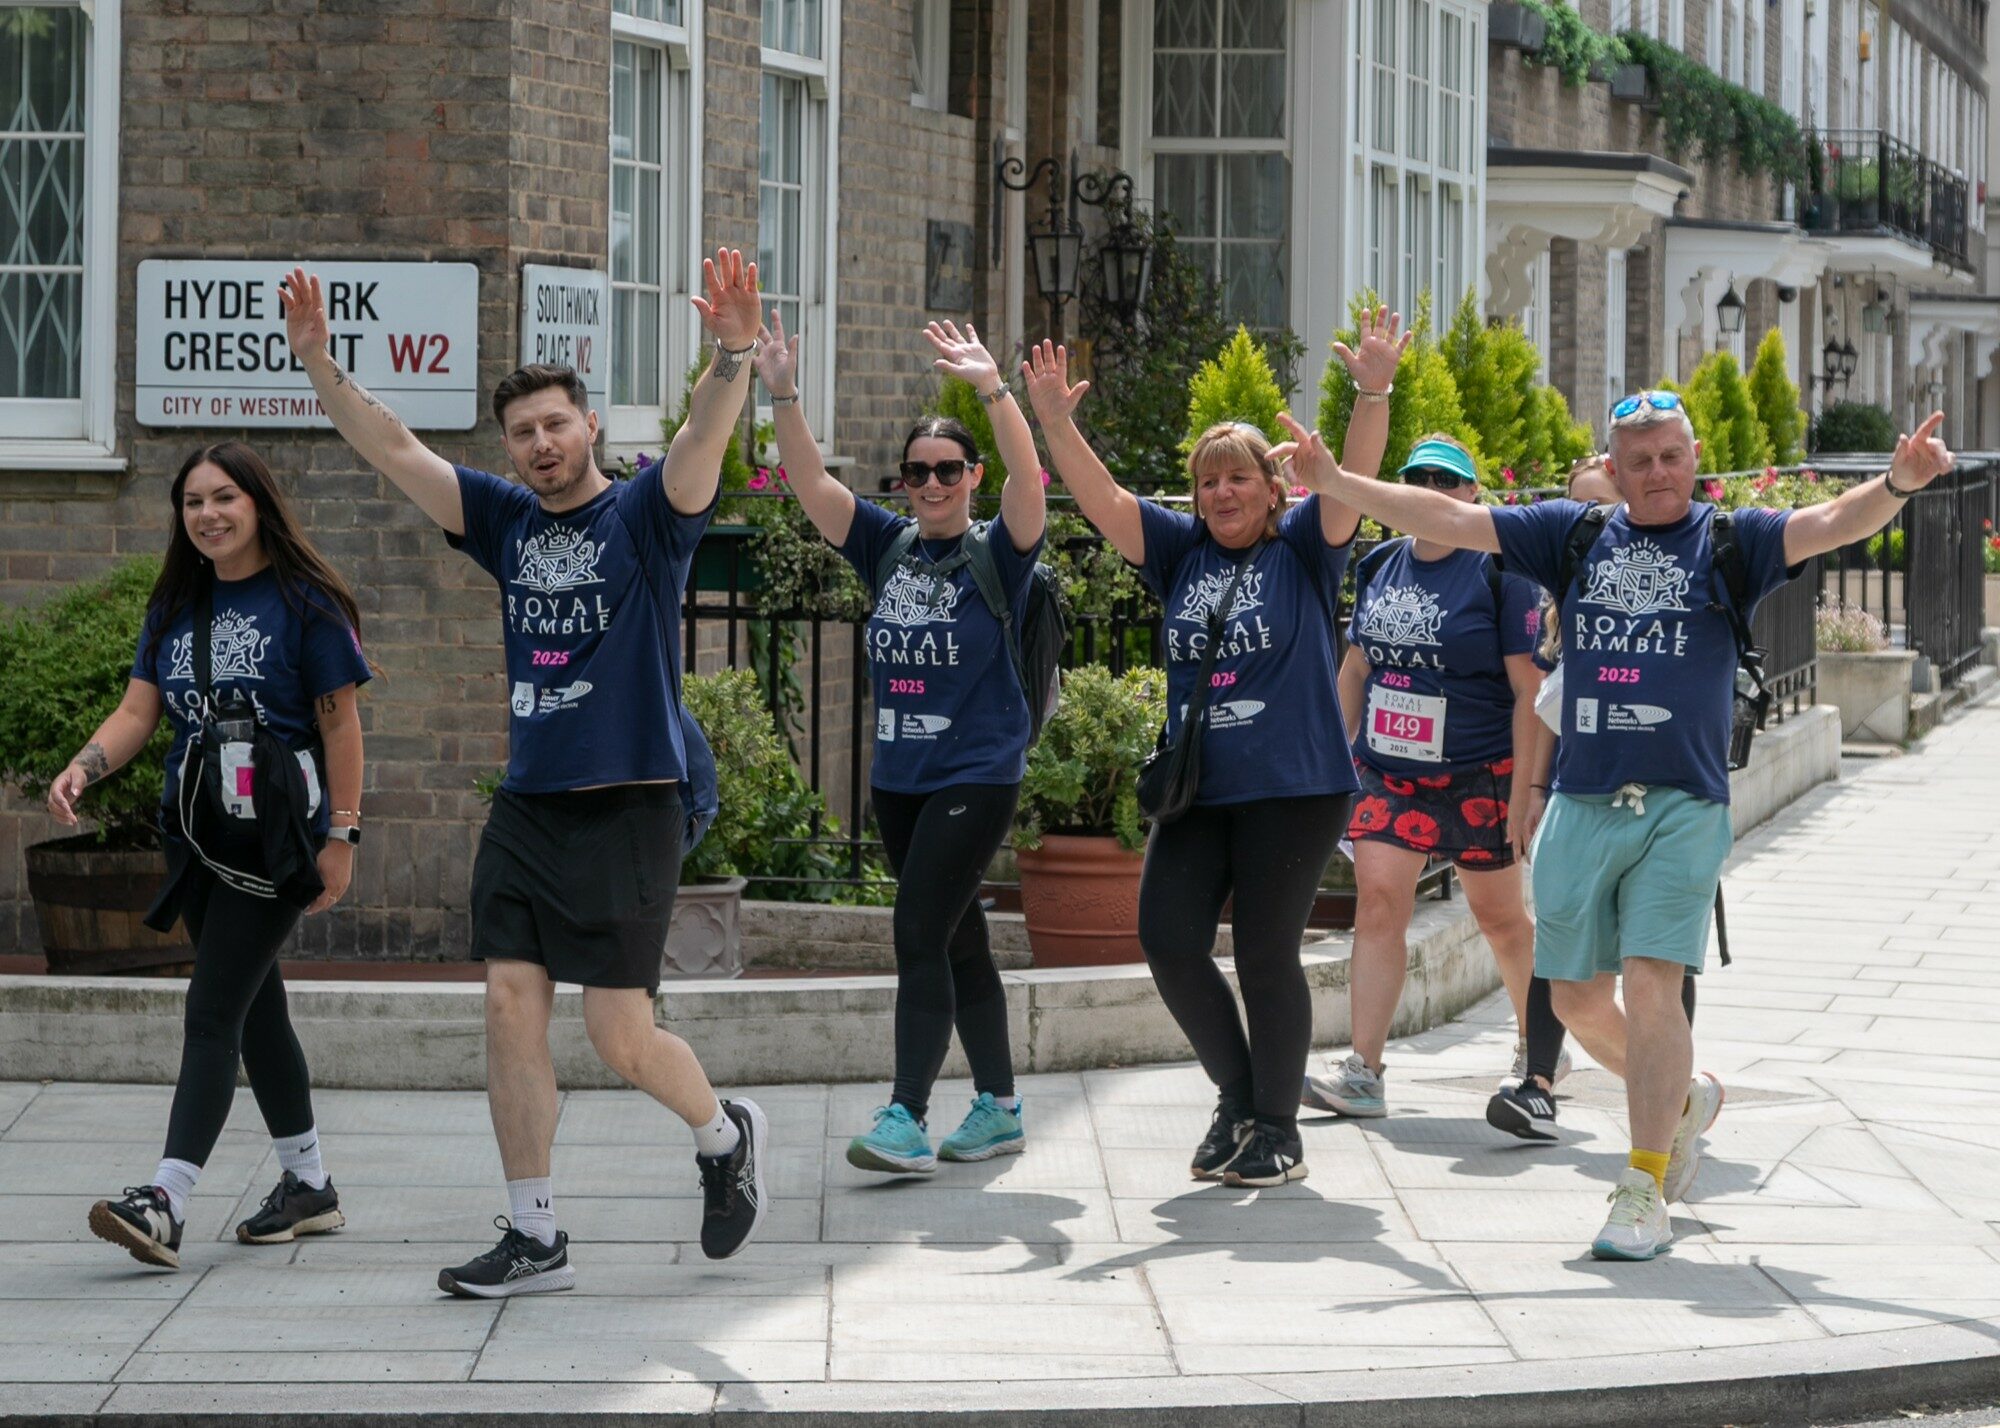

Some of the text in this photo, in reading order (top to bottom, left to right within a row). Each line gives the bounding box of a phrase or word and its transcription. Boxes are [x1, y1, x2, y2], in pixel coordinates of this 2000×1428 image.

[165, 280, 380, 321] HYDE RK
[537, 284, 599, 326] SOUTHWICK
[164, 331, 450, 374] CRESCT W2
[576, 335, 592, 374] W2
[163, 396, 327, 416] CITY OF WESTMIN
[508, 594, 610, 618] ROYAL
[1168, 614, 1270, 649] ROAL
[1576, 613, 1688, 640] ROYAL
[865, 628, 960, 650] ROYAL
[1576, 634, 1686, 656] RAMBLE
[532, 650, 570, 665] 2025
[1208, 671, 1237, 687] 025
[1381, 671, 1411, 688] 2025
[1598, 666, 1641, 683] 2025
[889, 679, 926, 694] 2025
[1385, 692, 1423, 706] ROYAL
[1607, 717, 1638, 725] Networks
[1608, 710, 1629, 718] Power
[1384, 712, 1420, 738] 149
[1390, 743, 1408, 753] 2025
